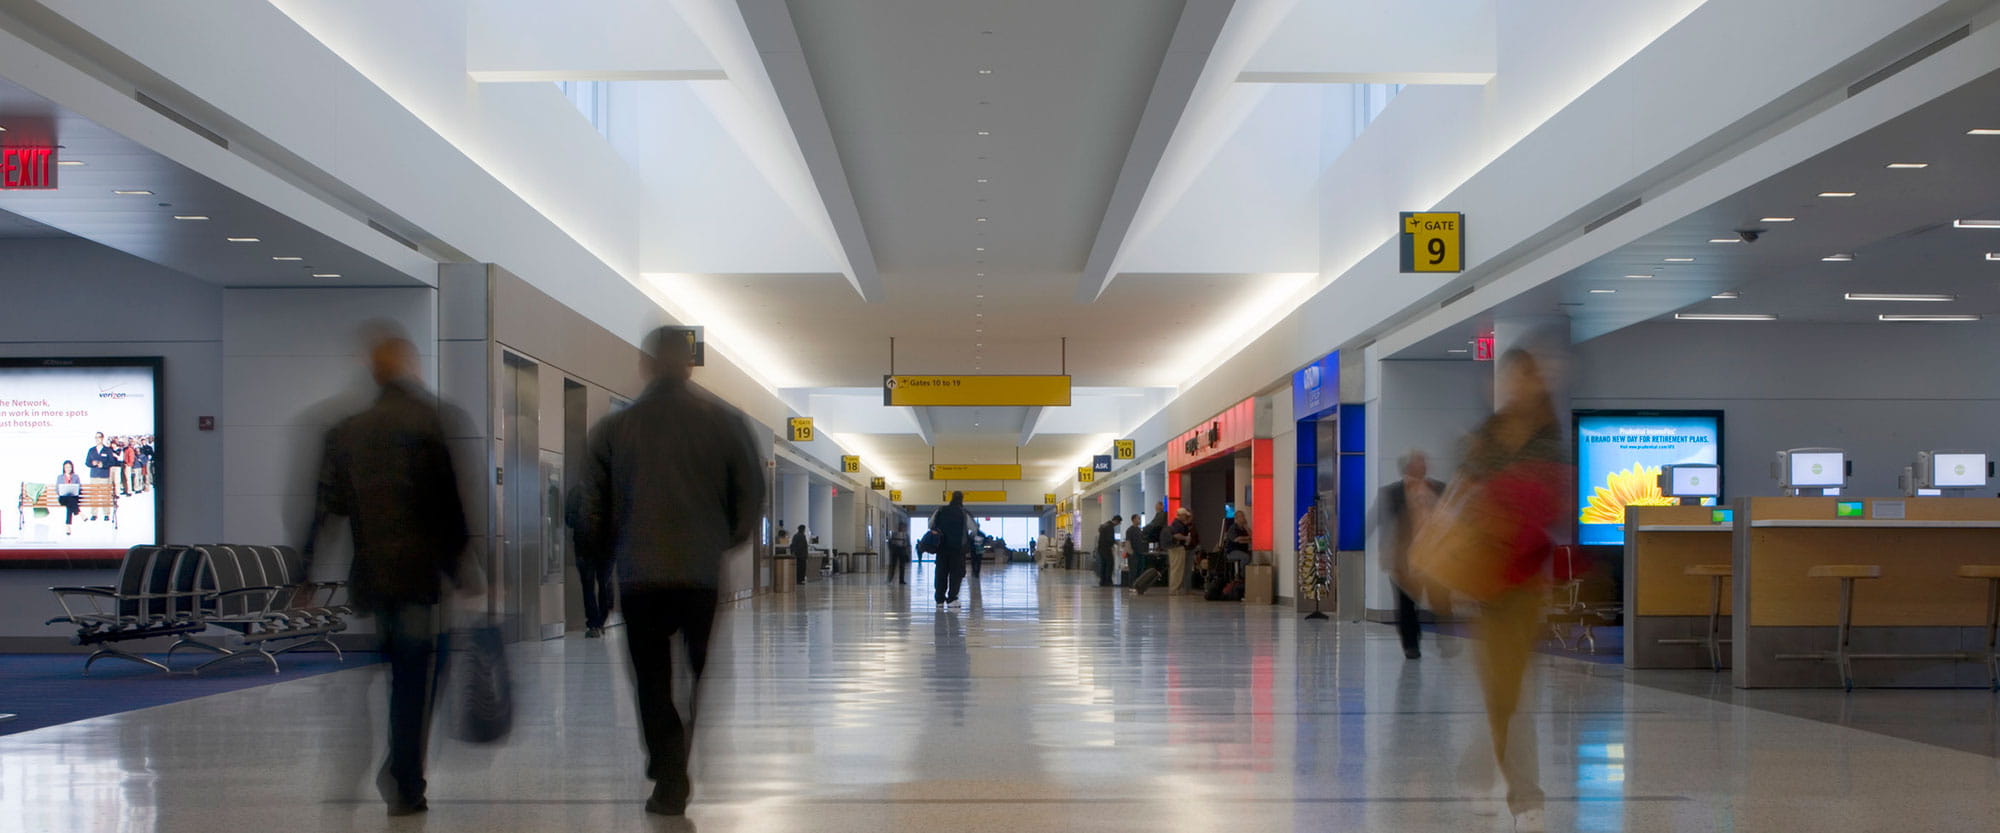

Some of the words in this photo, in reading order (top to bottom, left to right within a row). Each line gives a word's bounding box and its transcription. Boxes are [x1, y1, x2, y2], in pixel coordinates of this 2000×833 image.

[4, 149, 52, 187] EXIT
[1424, 221, 1455, 231] GATE
[1427, 237, 1446, 265] 9
[910, 379, 930, 387] Gates
[98, 392, 127, 400] verizon
[12, 399, 50, 408] Network,
[9, 409, 30, 417] work
[31, 409, 40, 417] in
[65, 409, 89, 419] spots
[13, 419, 54, 429] hotspots.
[796, 427, 811, 439] 19
[1585, 435, 1590, 443] A
[1591, 435, 1611, 443] BRAND
[1612, 435, 1626, 443] NEW
[1627, 435, 1638, 443] DAY
[1639, 435, 1651, 443] FOR
[1652, 435, 1688, 443] RETIREMENT
[1689, 435, 1710, 443] PLANS.
[1120, 447, 1132, 457] 10
[847, 462, 858, 471] 18
